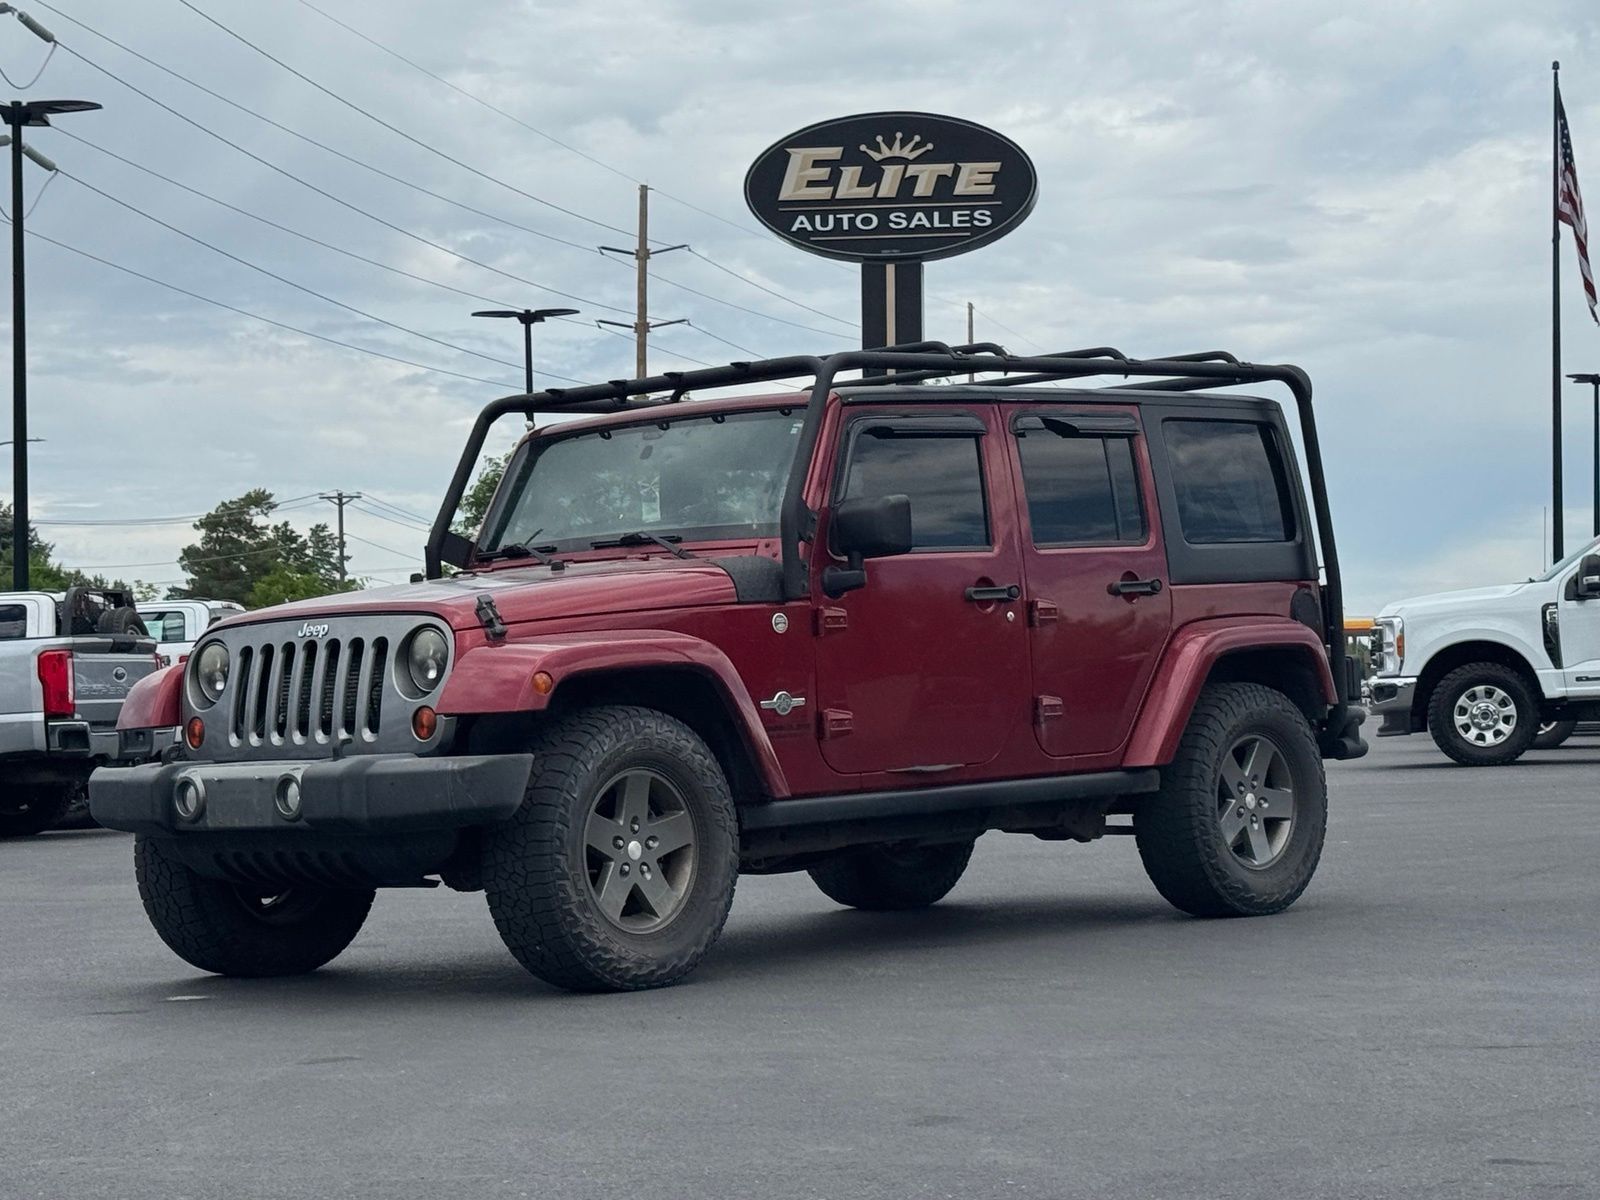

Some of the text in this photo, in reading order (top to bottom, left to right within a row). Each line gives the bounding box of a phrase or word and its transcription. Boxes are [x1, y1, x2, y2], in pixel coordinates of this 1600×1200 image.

[778, 147, 1002, 201] ELITE
[790, 210, 993, 232] AUTO SALES
[297, 622, 329, 639] Jeep
